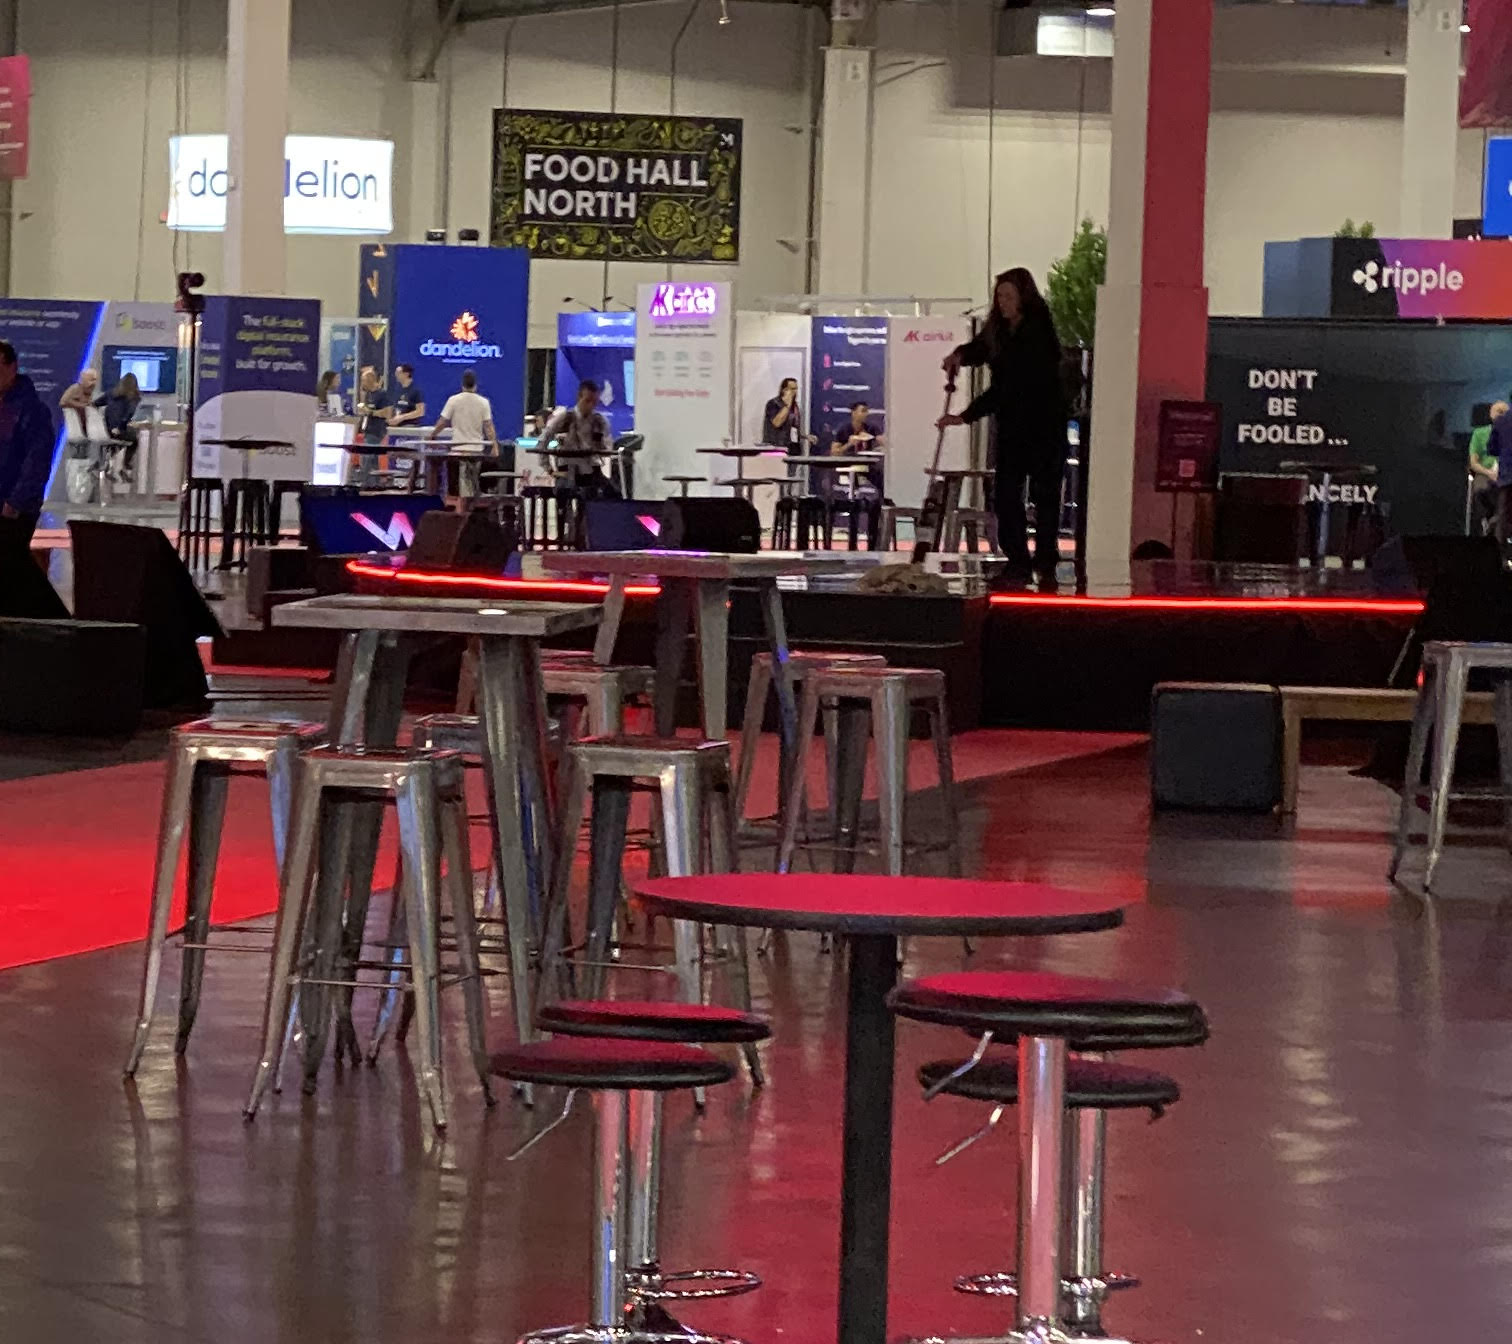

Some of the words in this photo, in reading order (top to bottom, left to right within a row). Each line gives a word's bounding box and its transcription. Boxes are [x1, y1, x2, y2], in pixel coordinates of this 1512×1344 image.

[189, 157, 378, 202] daelion
[524, 152, 620, 183] FOOD
[626, 157, 709, 188] HALL
[523, 187, 637, 218] NORTH
[1381, 259, 1465, 296] ripple
[1248, 368, 1319, 391] DON'T
[1266, 396, 1298, 417] BE
[1299, 483, 1379, 505] NCELY
